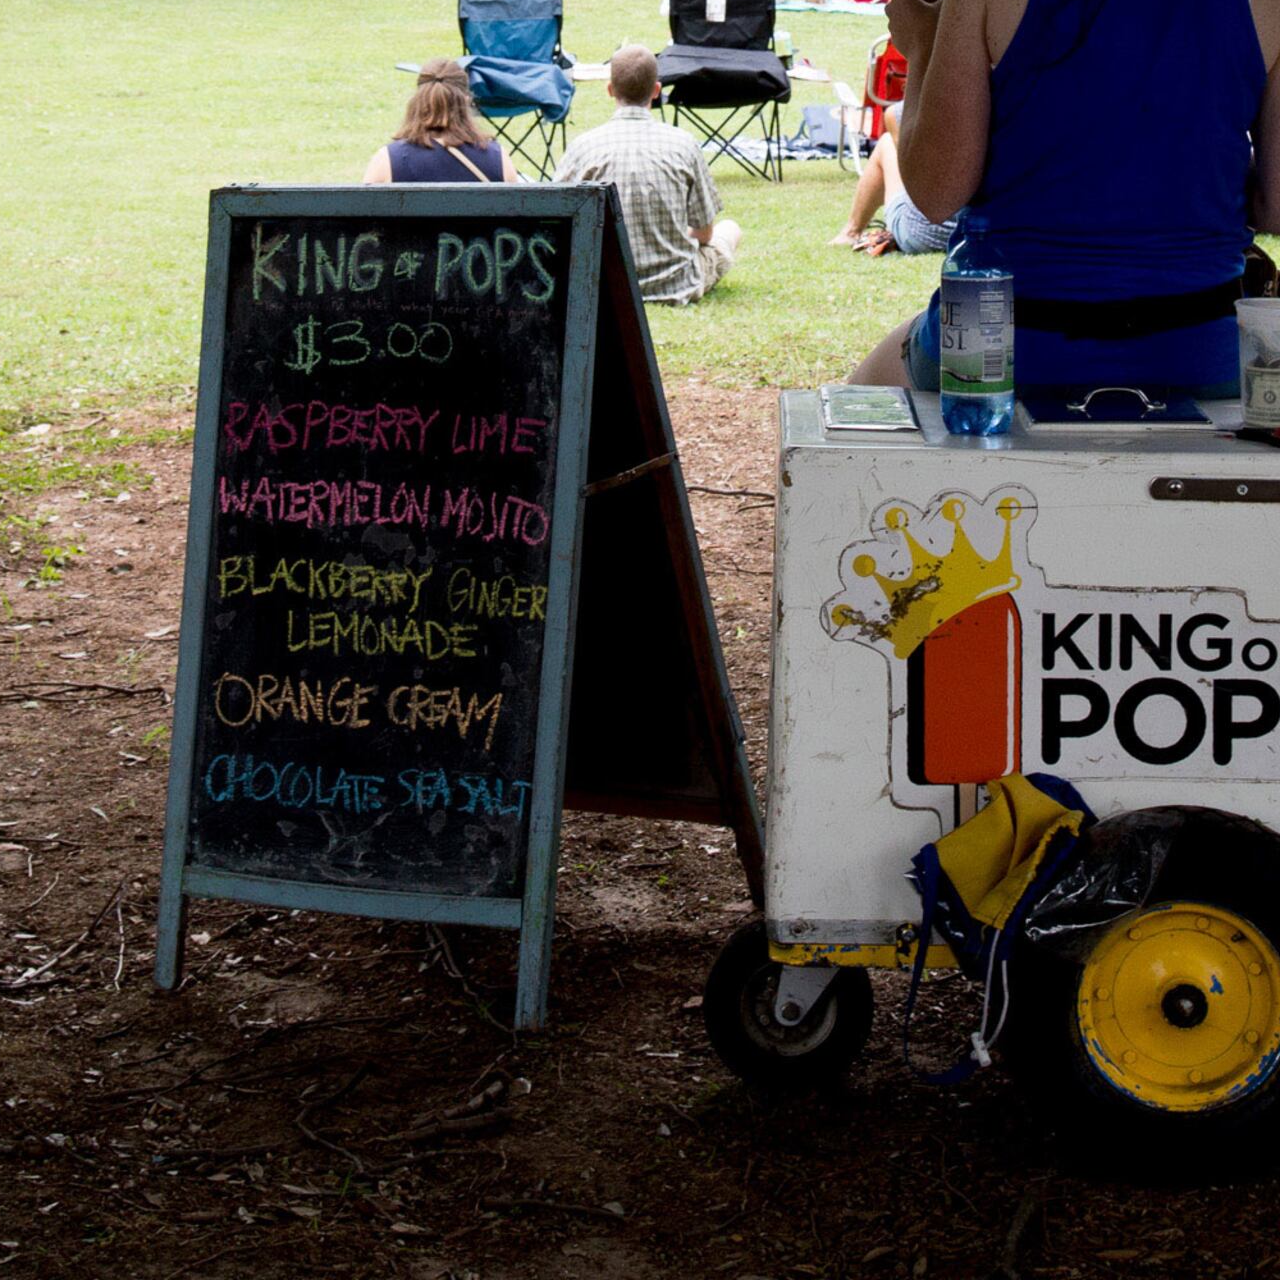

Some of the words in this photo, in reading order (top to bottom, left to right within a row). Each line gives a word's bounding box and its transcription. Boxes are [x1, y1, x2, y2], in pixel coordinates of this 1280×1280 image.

[251, 221, 383, 301] KING
[434, 227, 556, 304] POPS
[283, 314, 453, 375] $3.00
[223, 401, 440, 455] RASPBERRY
[452, 410, 547, 455] LIME
[219, 476, 431, 531] WATERMELON
[440, 487, 550, 546] MOJITO
[219, 555, 432, 613] BLACKBERRY
[448, 568, 548, 620] GINGER
[287, 610, 478, 660] LEMONADE
[1041, 613, 1233, 672] KING
[213, 672, 379, 729] ORANGE
[387, 684, 503, 752] CREAM
[205, 754, 385, 813] CHOCOLATE
[398, 768, 451, 811] SEA
[457, 774, 533, 818] SALT
